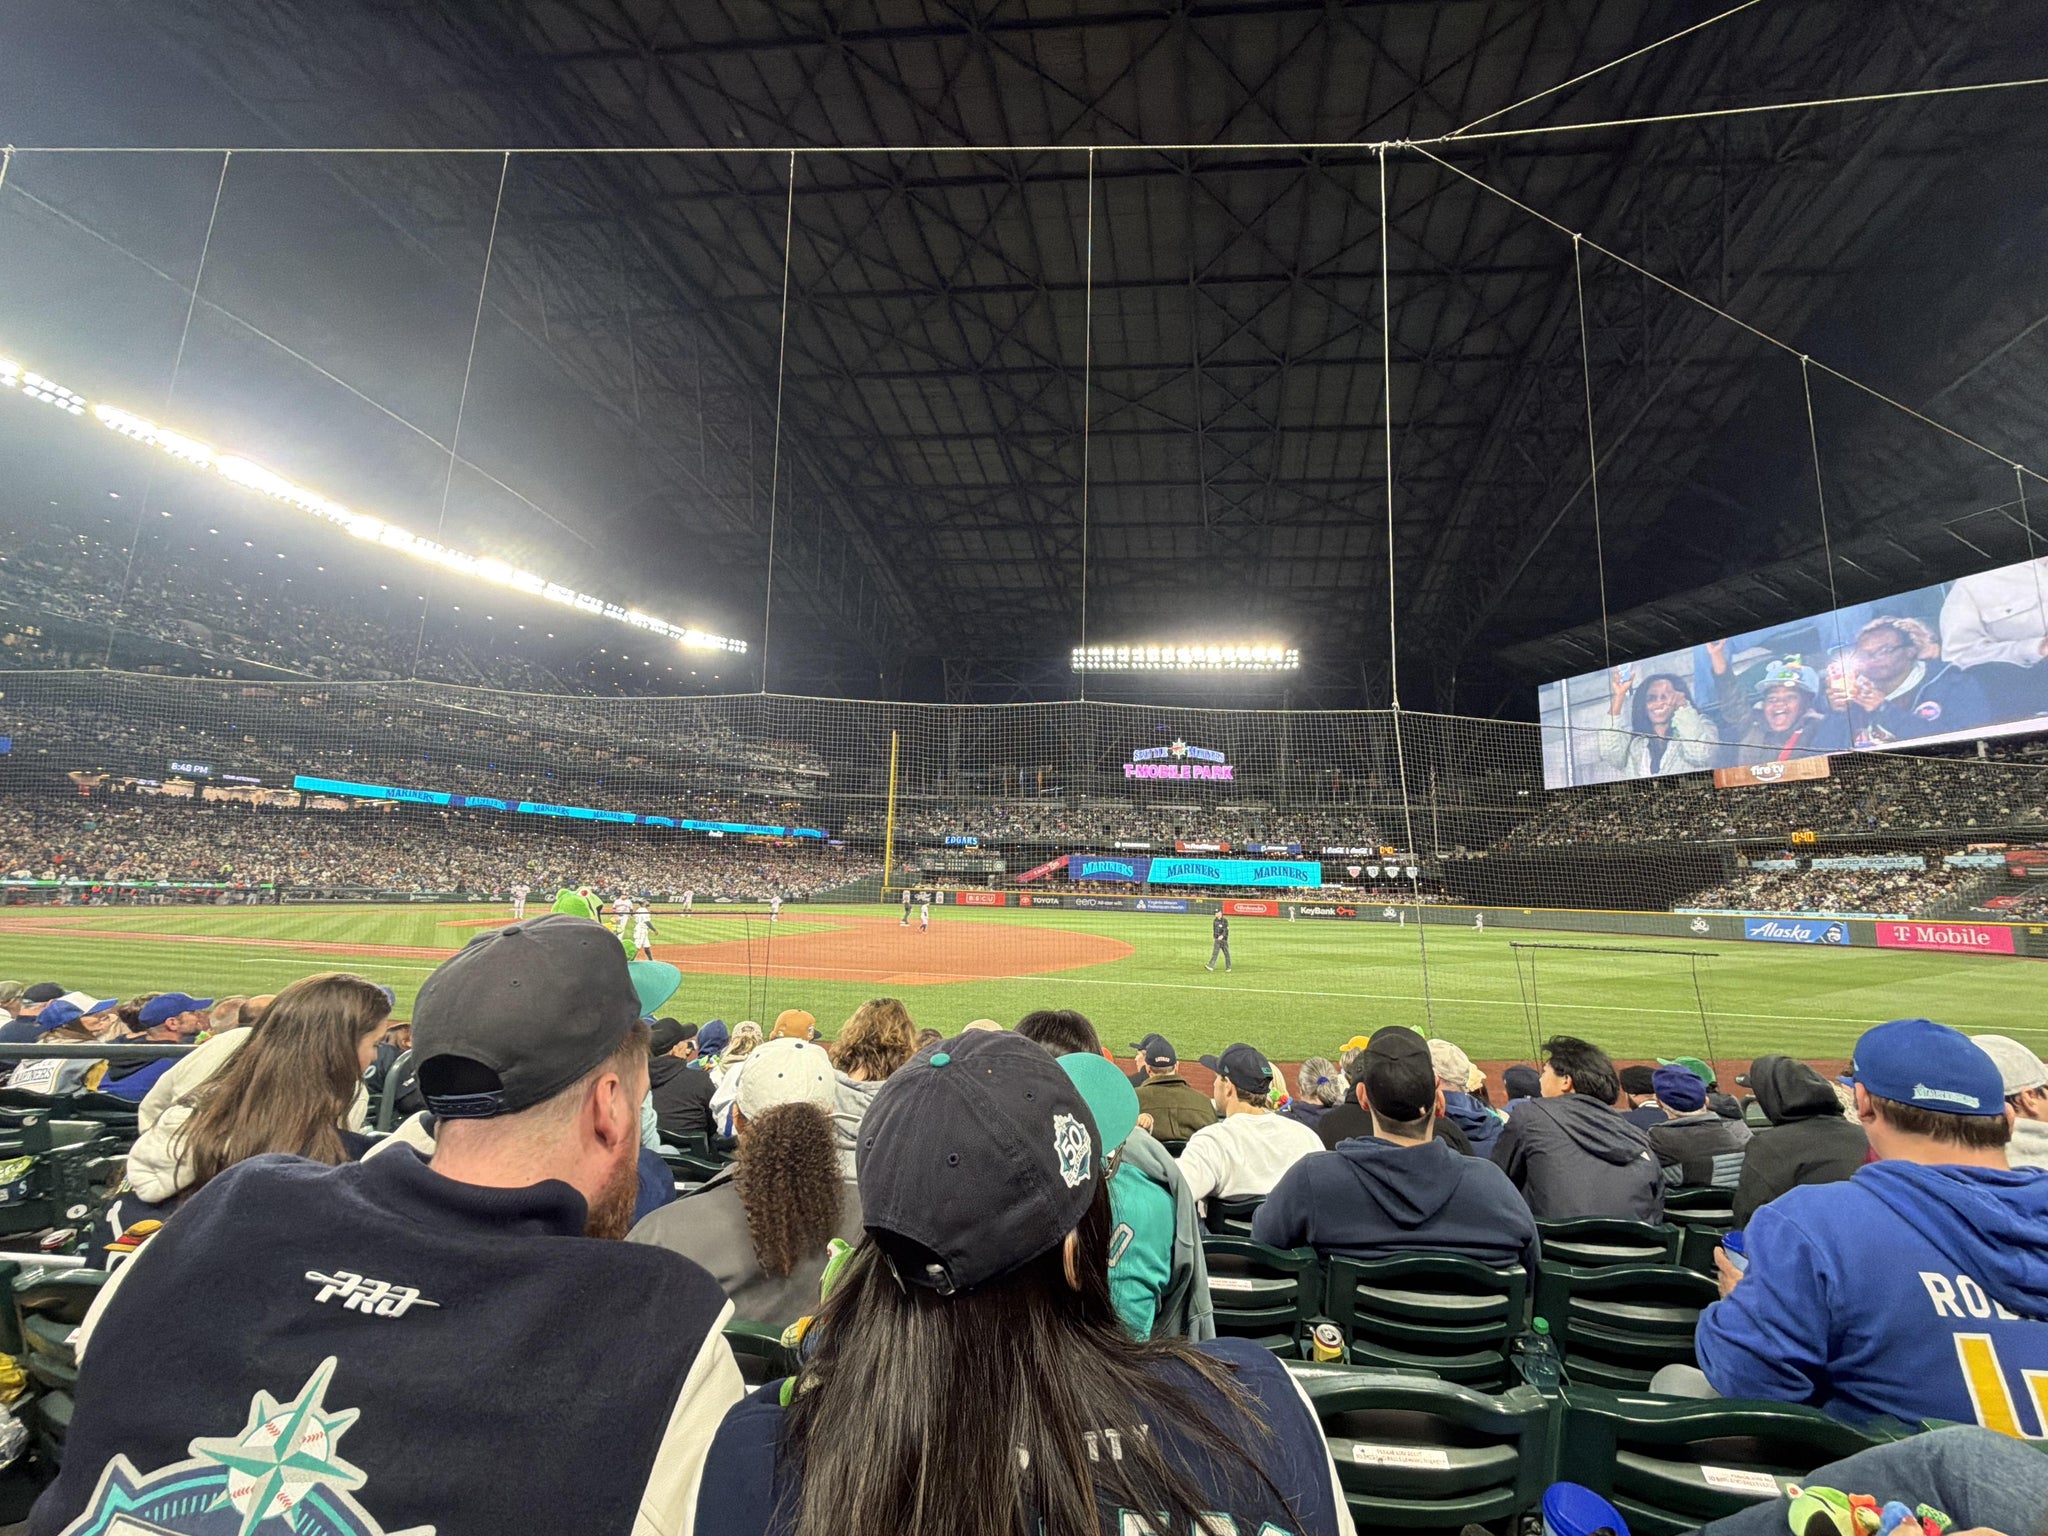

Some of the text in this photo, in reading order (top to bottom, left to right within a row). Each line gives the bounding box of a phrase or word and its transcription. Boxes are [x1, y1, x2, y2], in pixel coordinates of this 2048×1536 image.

[1123, 764, 1234, 780] T-MOBILE PARK
[1750, 764, 1785, 776] fire tv
[386, 788, 435, 802] MARINERS
[1791, 832, 1815, 843] 0:40
[1081, 861, 1134, 877] MARINERS
[1167, 863, 1220, 879] MARINERS
[1254, 865, 1309, 881] MARINERS
[1075, 898, 1097, 907] eero
[1236, 904, 1265, 912] Nintendo
[1300, 907, 1336, 916] KeyBank
[1750, 921, 1812, 941] Alaska
[1915, 926, 1991, 945] Mobile
[1060, 1125, 1083, 1166] 50
